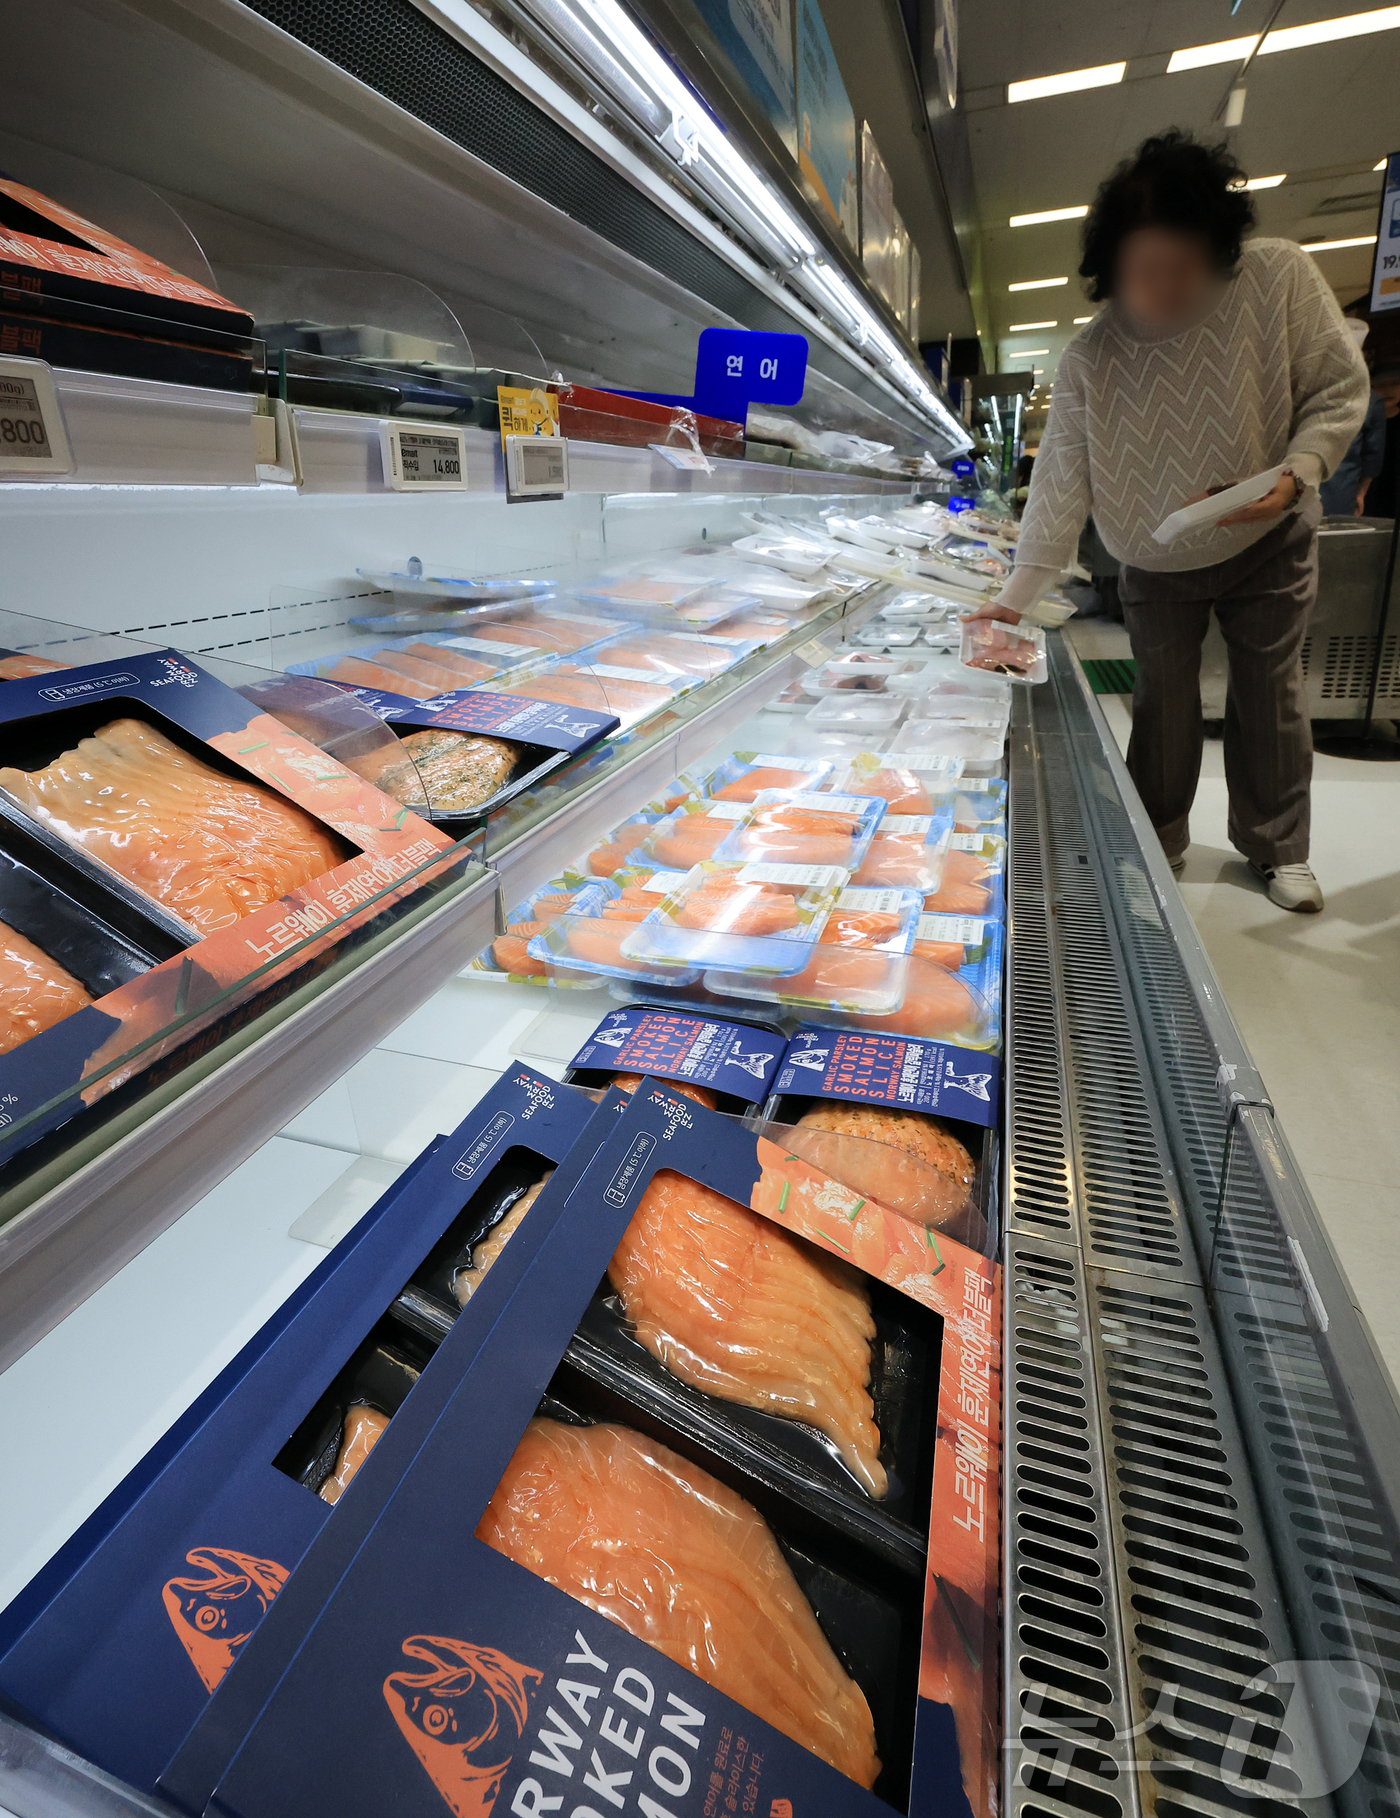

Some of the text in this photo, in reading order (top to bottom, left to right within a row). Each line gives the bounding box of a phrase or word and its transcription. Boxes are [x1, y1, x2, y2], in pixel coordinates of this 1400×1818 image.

[0, 418, 45, 444] 800
[433, 459, 460, 475] 14,800
[245, 898, 337, 964] 노르웨이
[613, 1041, 634, 1066] GARLIC
[624, 1016, 667, 1067] SMOKED
[638, 1017, 681, 1069] SALMON
[653, 1019, 696, 1072] SLICE
[822, 1034, 847, 1091] GARLIC PARSLEY
[834, 1036, 863, 1093] SMOKED
[852, 1037, 879, 1096] SALMON
[868, 1039, 896, 1098] SLICE
[886, 1041, 906, 1099] NORWAY SALMON
[521, 1085, 551, 1120] SEAFOOD
[662, 1103, 687, 1141] SEAFOOD
[952, 1418, 990, 1544] 노르웨이
[571, 1667, 655, 1818] KED
[638, 1692, 706, 1818] ON
[703, 1770, 725, 1818] 연어를
[725, 1736, 750, 1812] 슬라이스한
